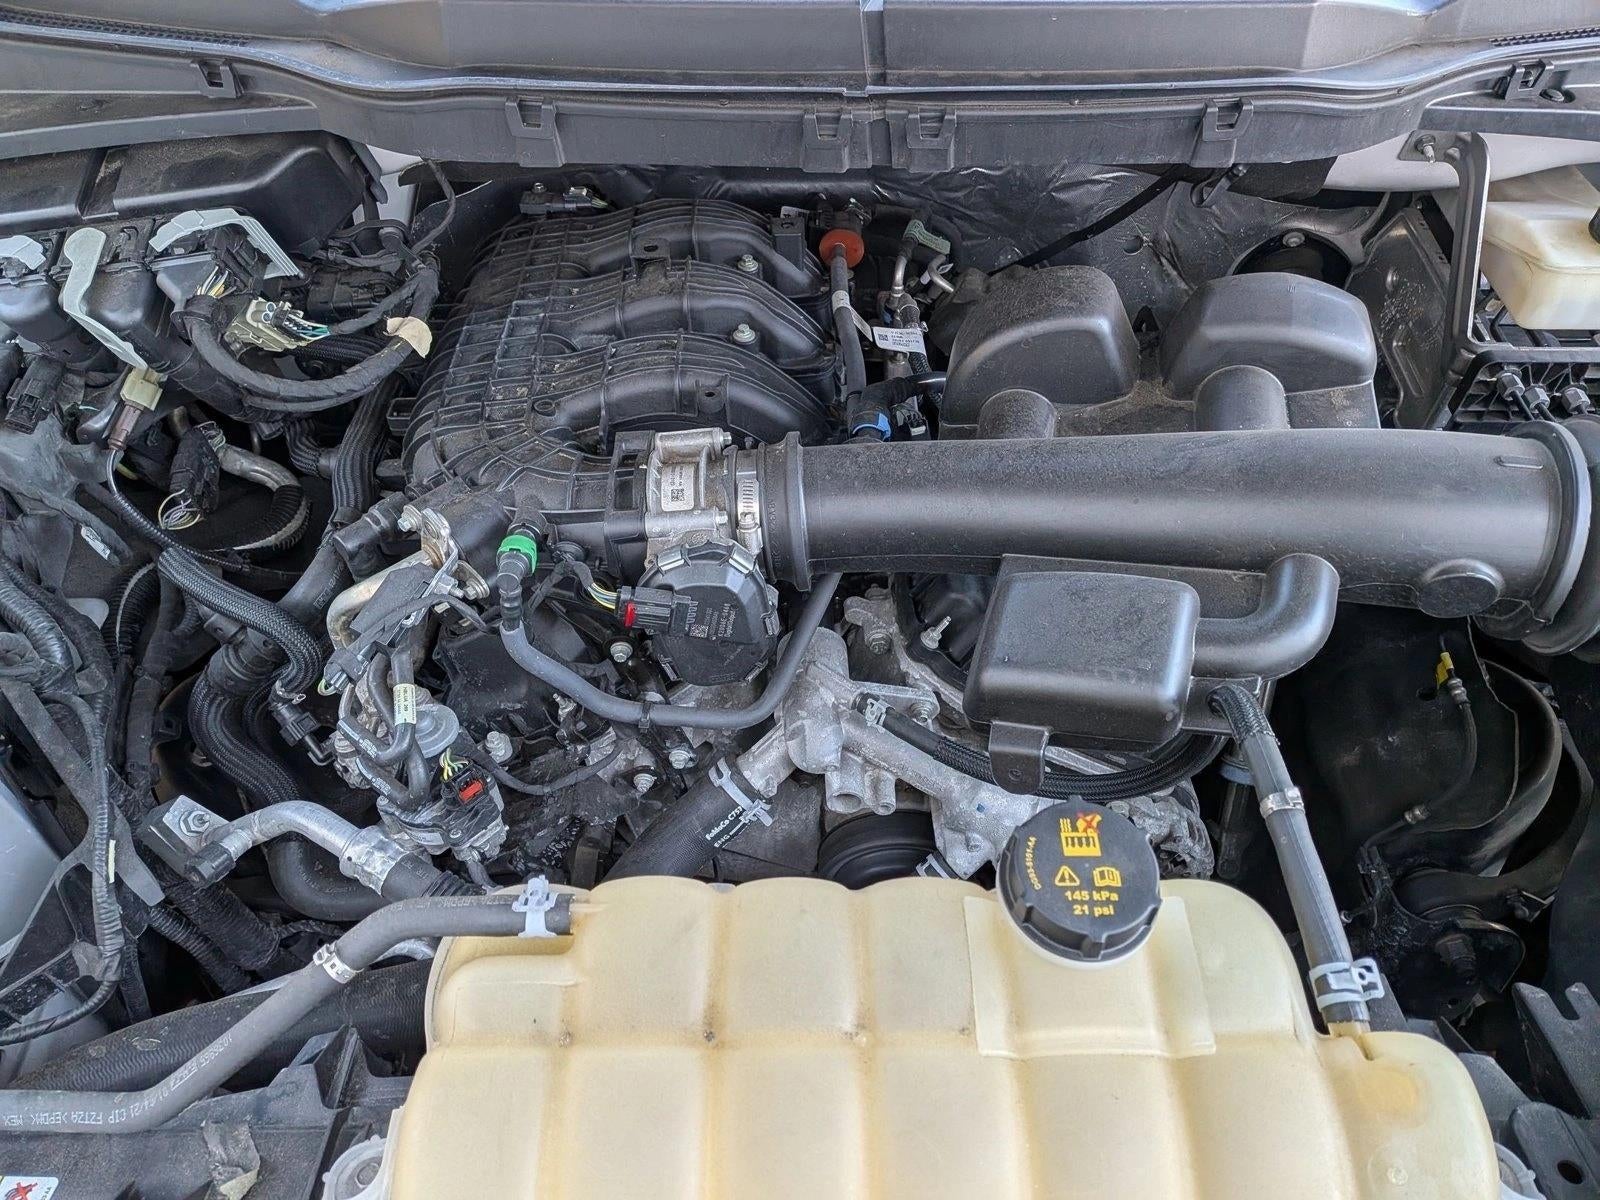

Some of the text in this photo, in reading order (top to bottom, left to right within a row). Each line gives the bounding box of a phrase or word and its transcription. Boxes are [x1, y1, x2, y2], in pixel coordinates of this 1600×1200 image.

[1065, 890, 1119, 901] 145 kPa
[1072, 904, 1115, 917] 21 psi
